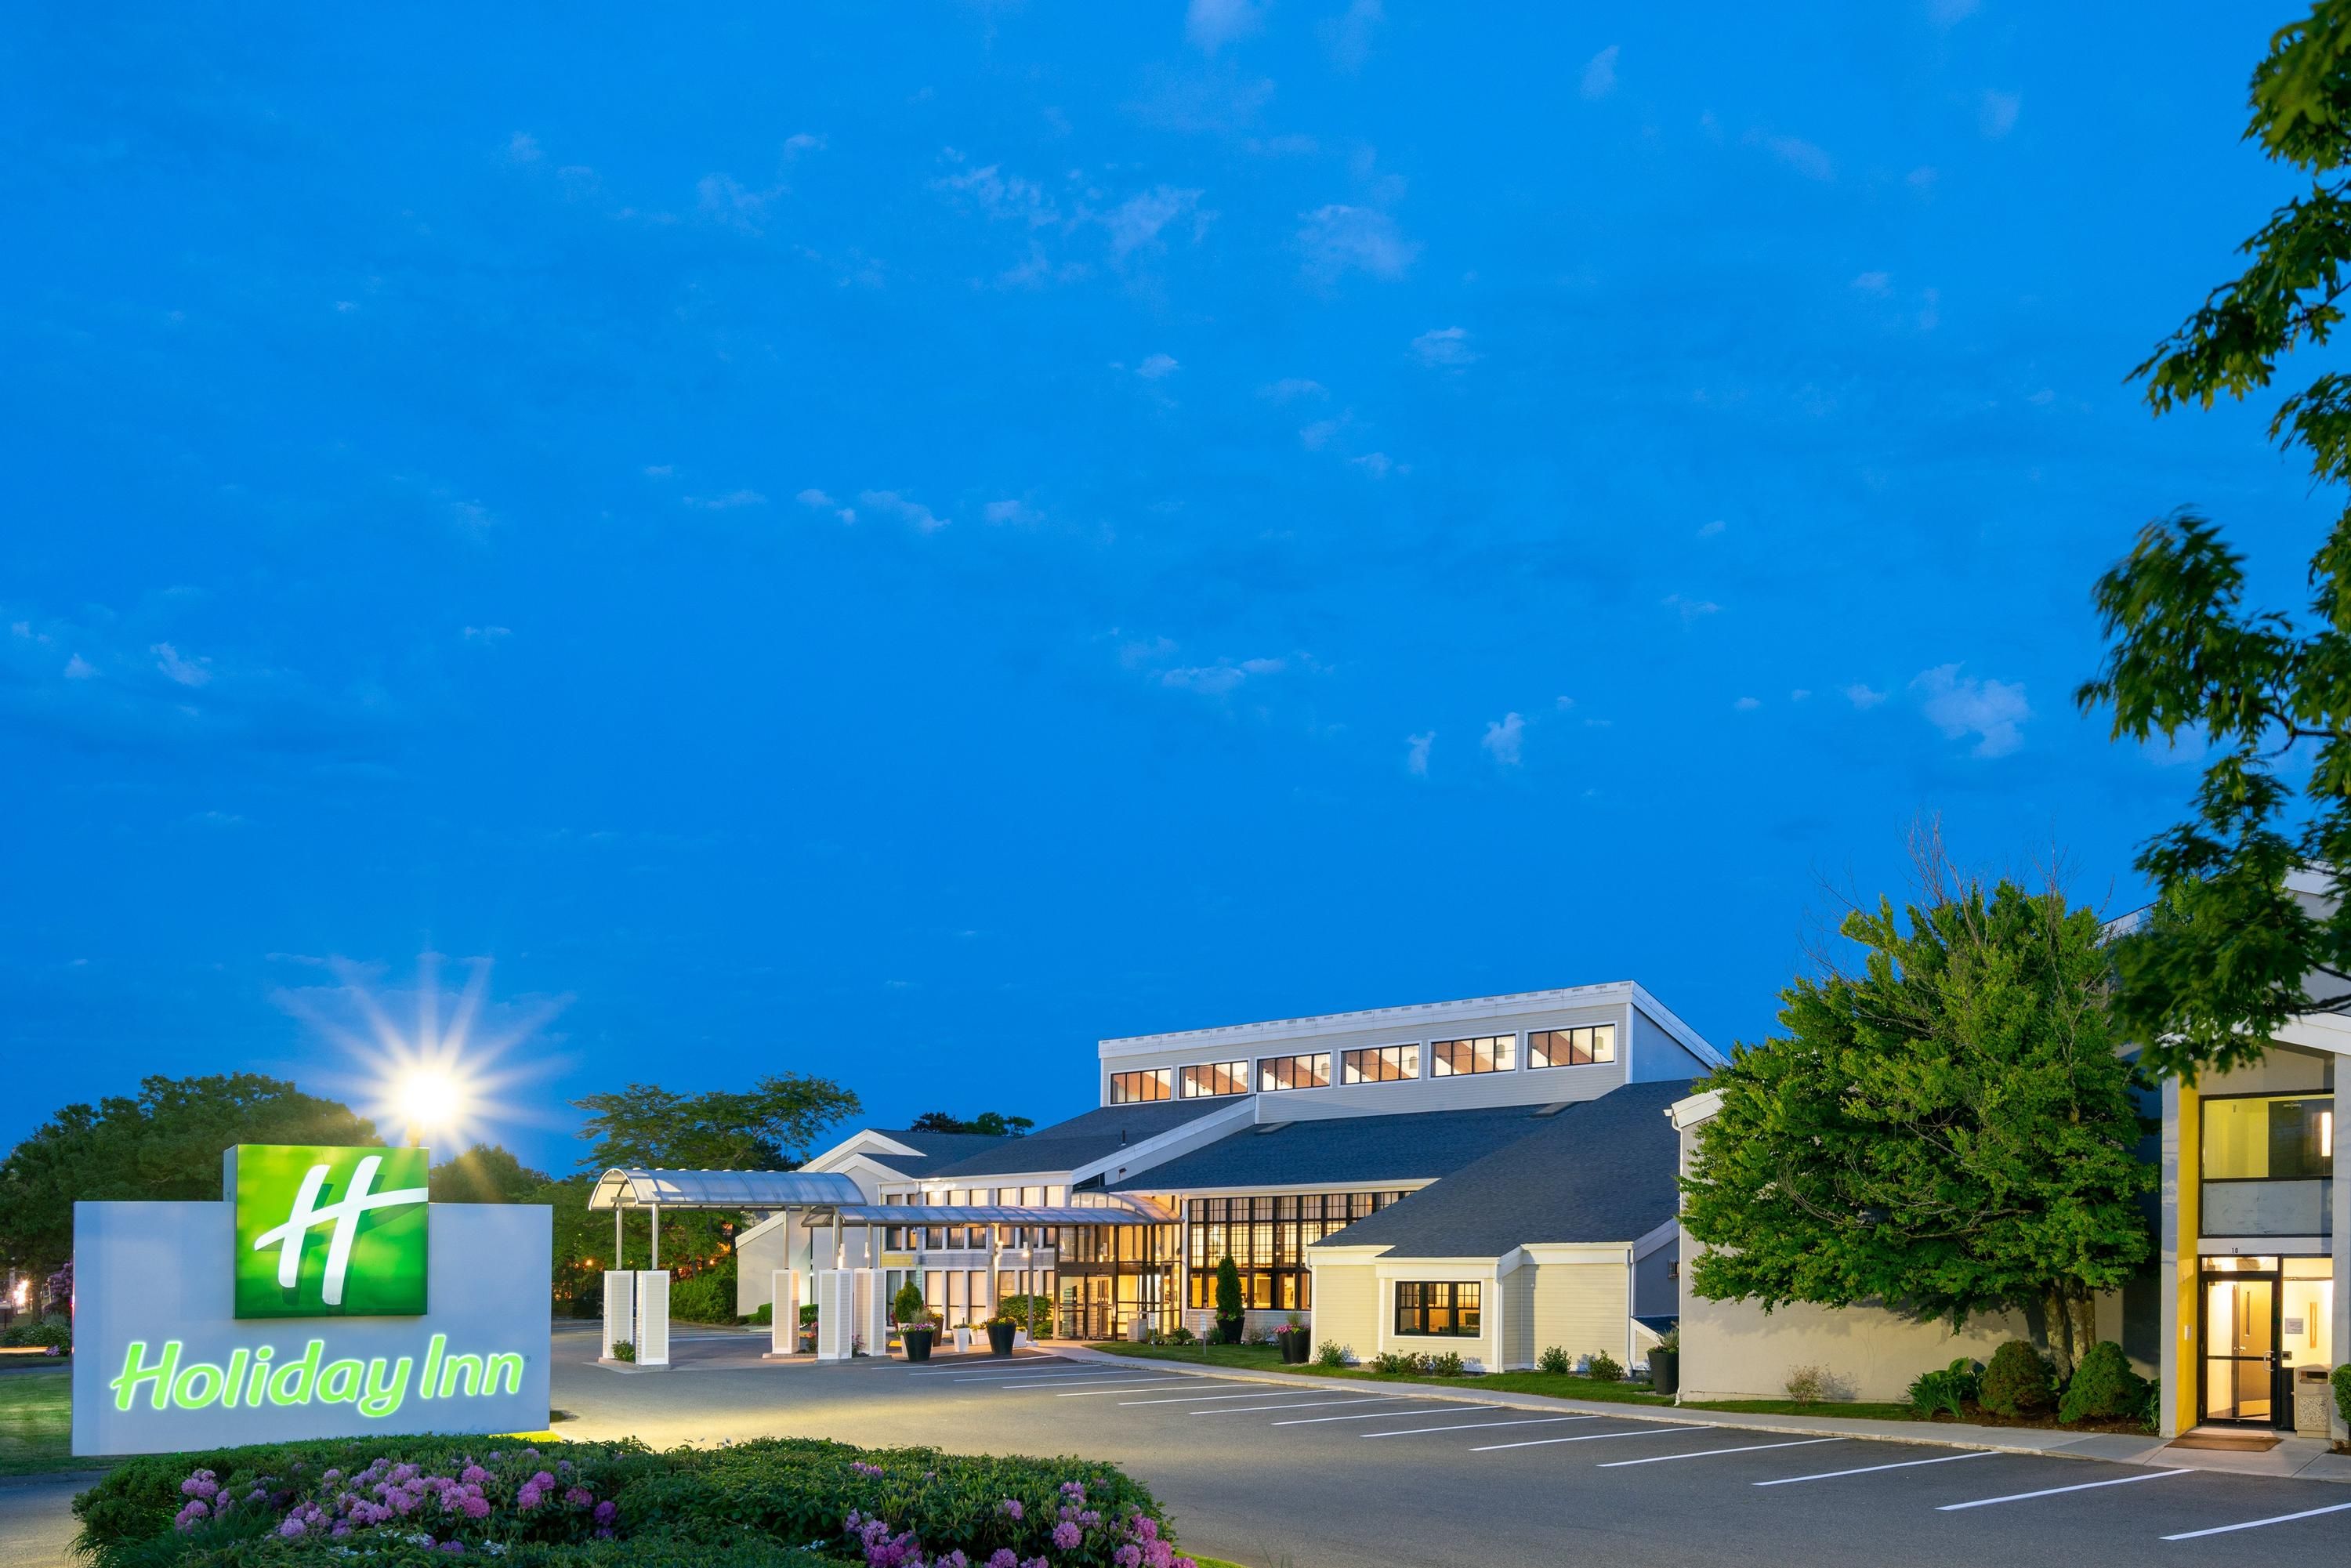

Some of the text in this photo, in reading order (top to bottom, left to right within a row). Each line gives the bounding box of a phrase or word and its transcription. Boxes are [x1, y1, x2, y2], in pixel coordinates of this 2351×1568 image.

[254, 1155, 429, 1305] H
[110, 1334, 523, 1418] Holiday Inn
